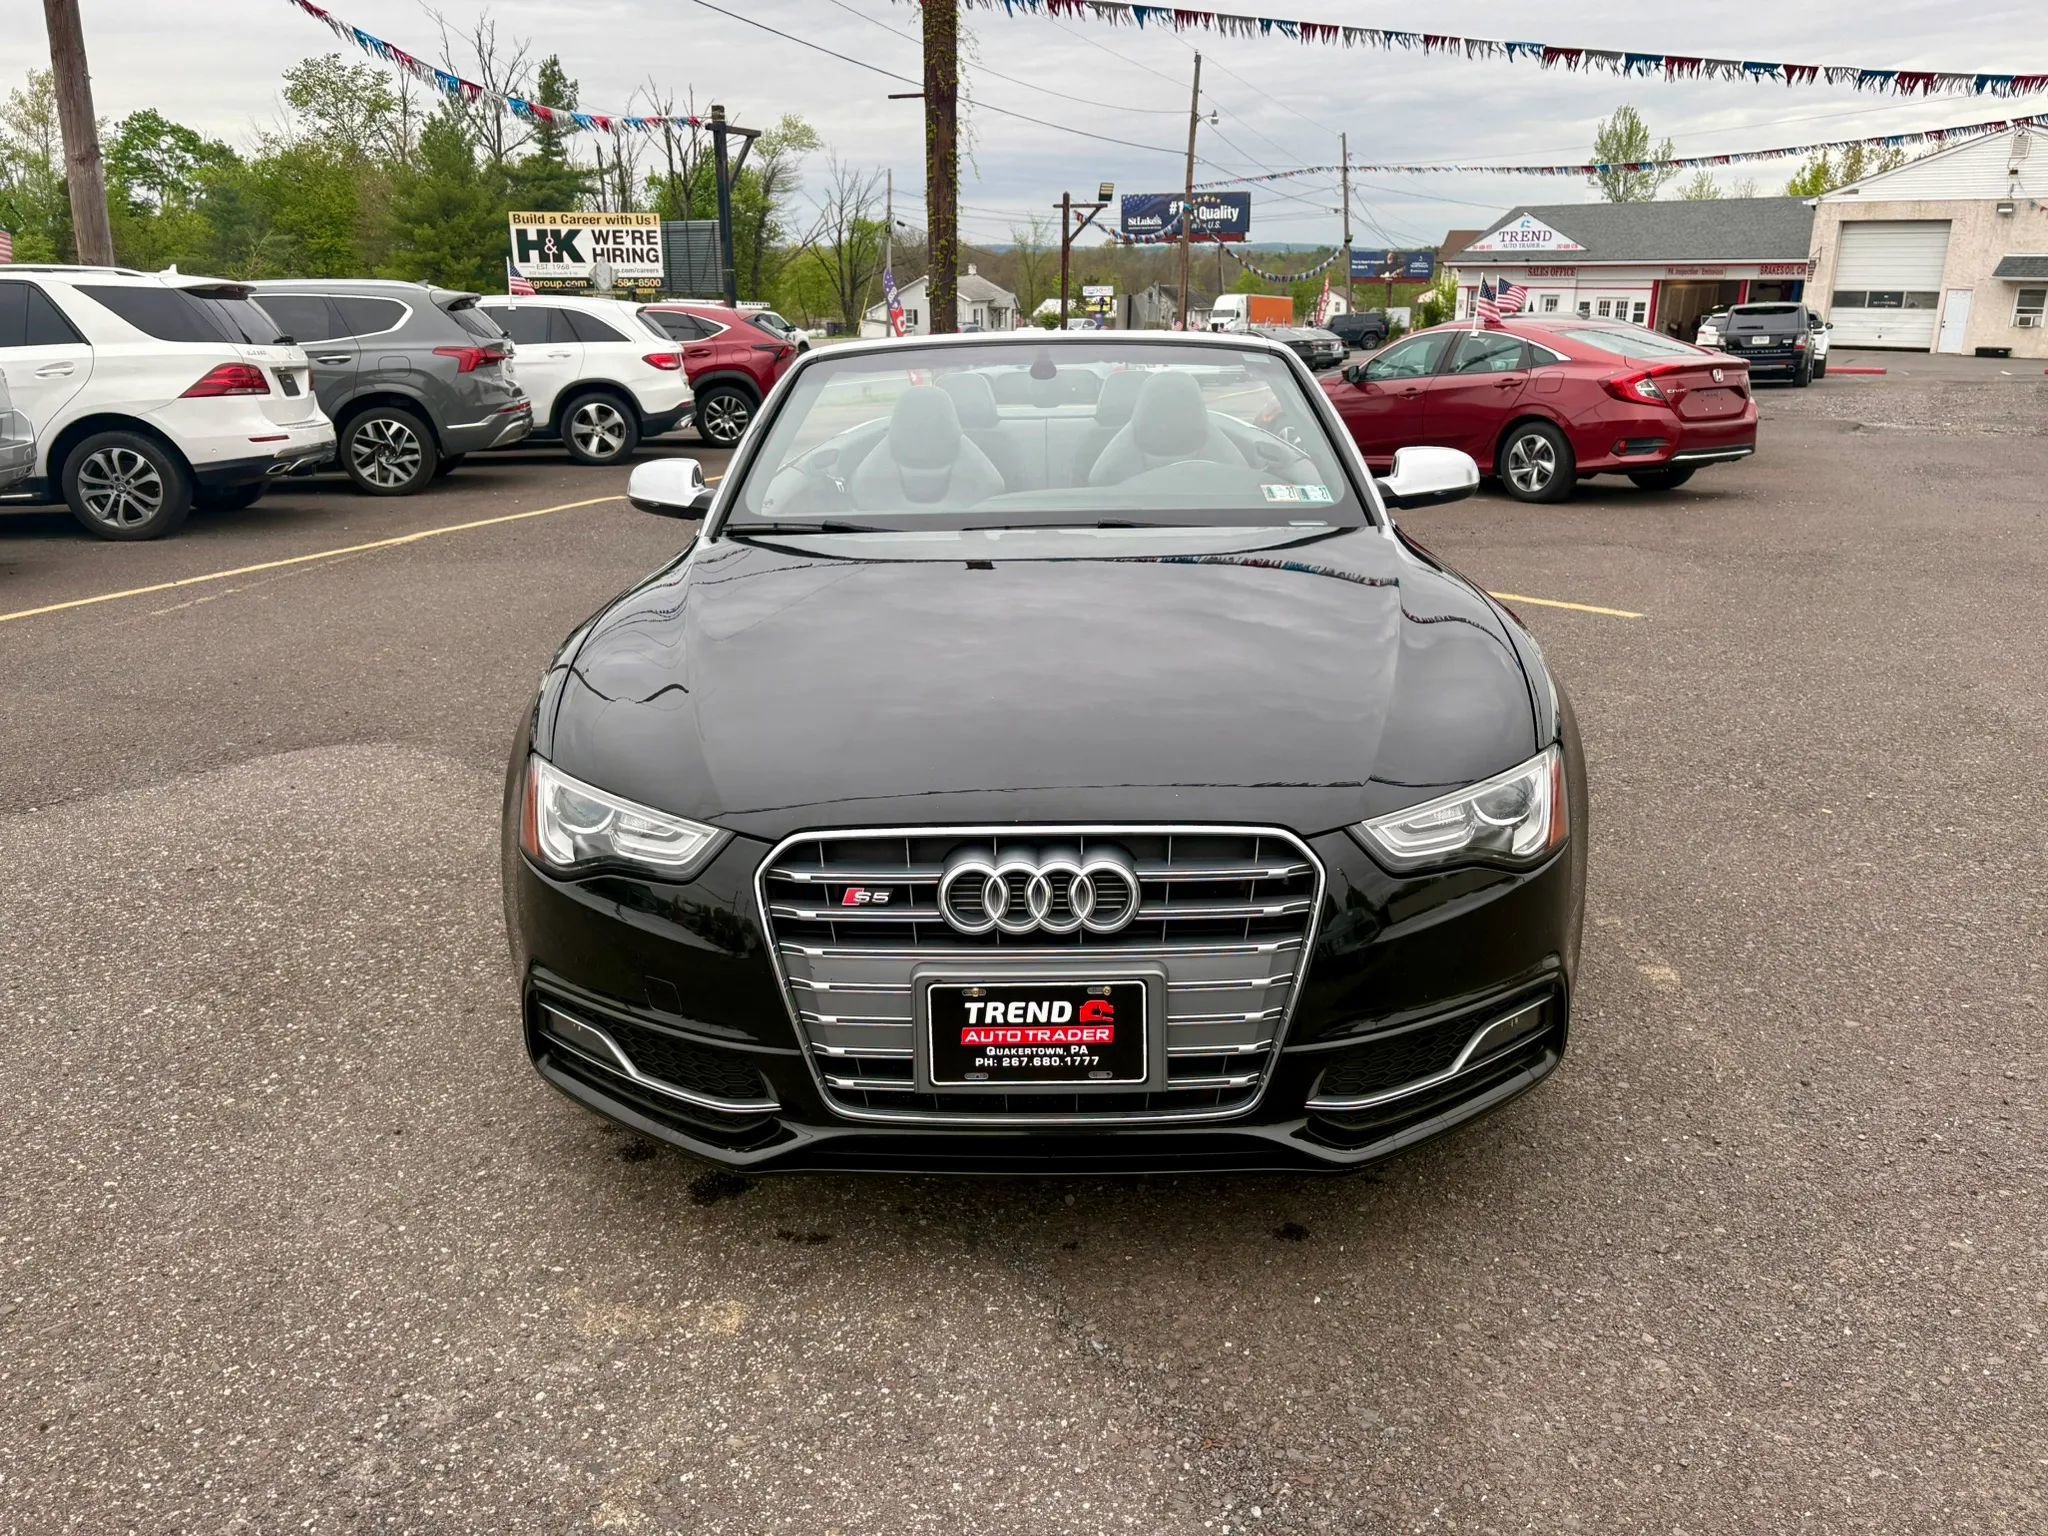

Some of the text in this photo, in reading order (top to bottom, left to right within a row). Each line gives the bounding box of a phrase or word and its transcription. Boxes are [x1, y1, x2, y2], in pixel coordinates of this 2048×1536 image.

[1199, 205, 1240, 222] Quality
[512, 214, 546, 225] Build
[550, 216, 557, 225] a
[560, 214, 601, 225] Career
[605, 215, 632, 226] with
[1207, 220, 1221, 229] U.S.
[591, 229, 659, 246] WE'RE
[1498, 230, 1553, 243] TREND
[515, 229, 587, 264] H&K
[592, 247, 660, 264] HIRING
[1527, 266, 1577, 277] SALES OFFICE
[1760, 264, 1785, 275] BRAKES
[1785, 264, 1796, 275] OIL
[853, 892, 890, 903] S5
[964, 1000, 1073, 1024] TREND
[964, 1029, 1111, 1043] AUTO TRADER
[1071, 1045, 1089, 1056] PA
[975, 1056, 1100, 1067] PH: 267.680.1777
